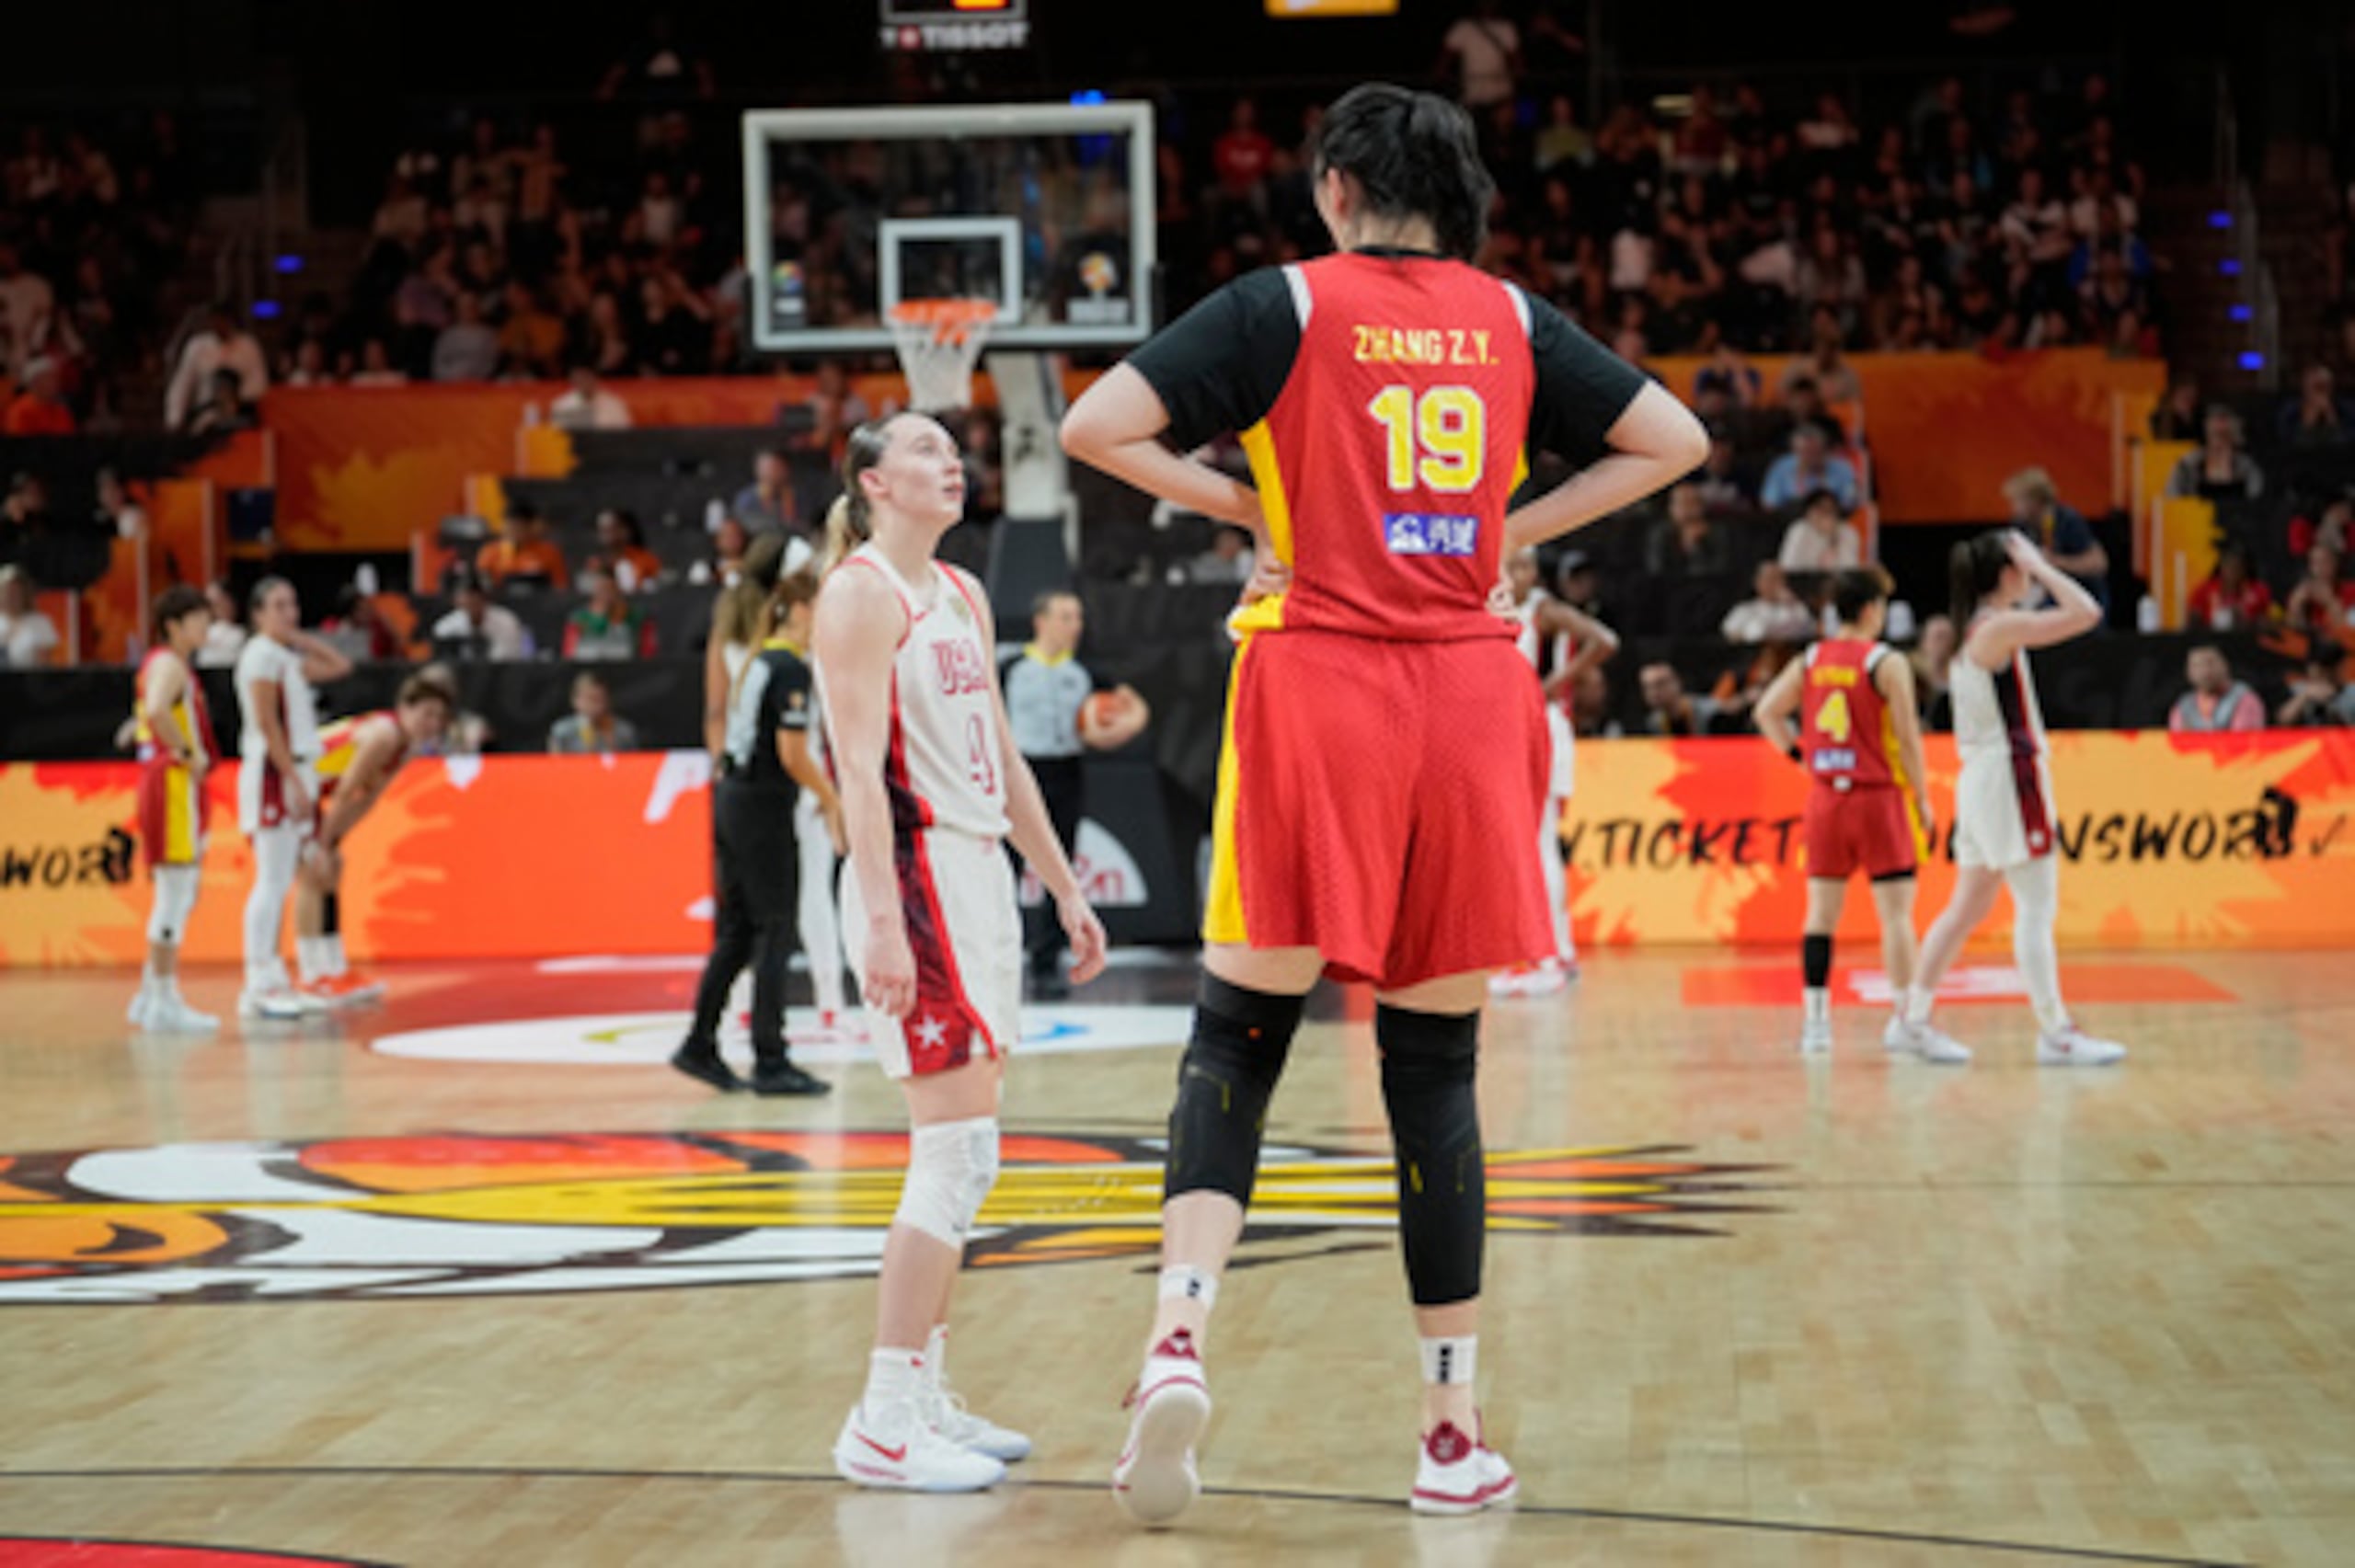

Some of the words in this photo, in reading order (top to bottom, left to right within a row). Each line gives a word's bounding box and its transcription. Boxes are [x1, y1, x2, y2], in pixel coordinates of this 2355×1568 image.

[1352, 326, 1443, 364] ZHANG
[1447, 329, 1500, 365] Z.Y.
[1368, 384, 1487, 491] 19
[1815, 689, 1851, 743] 4
